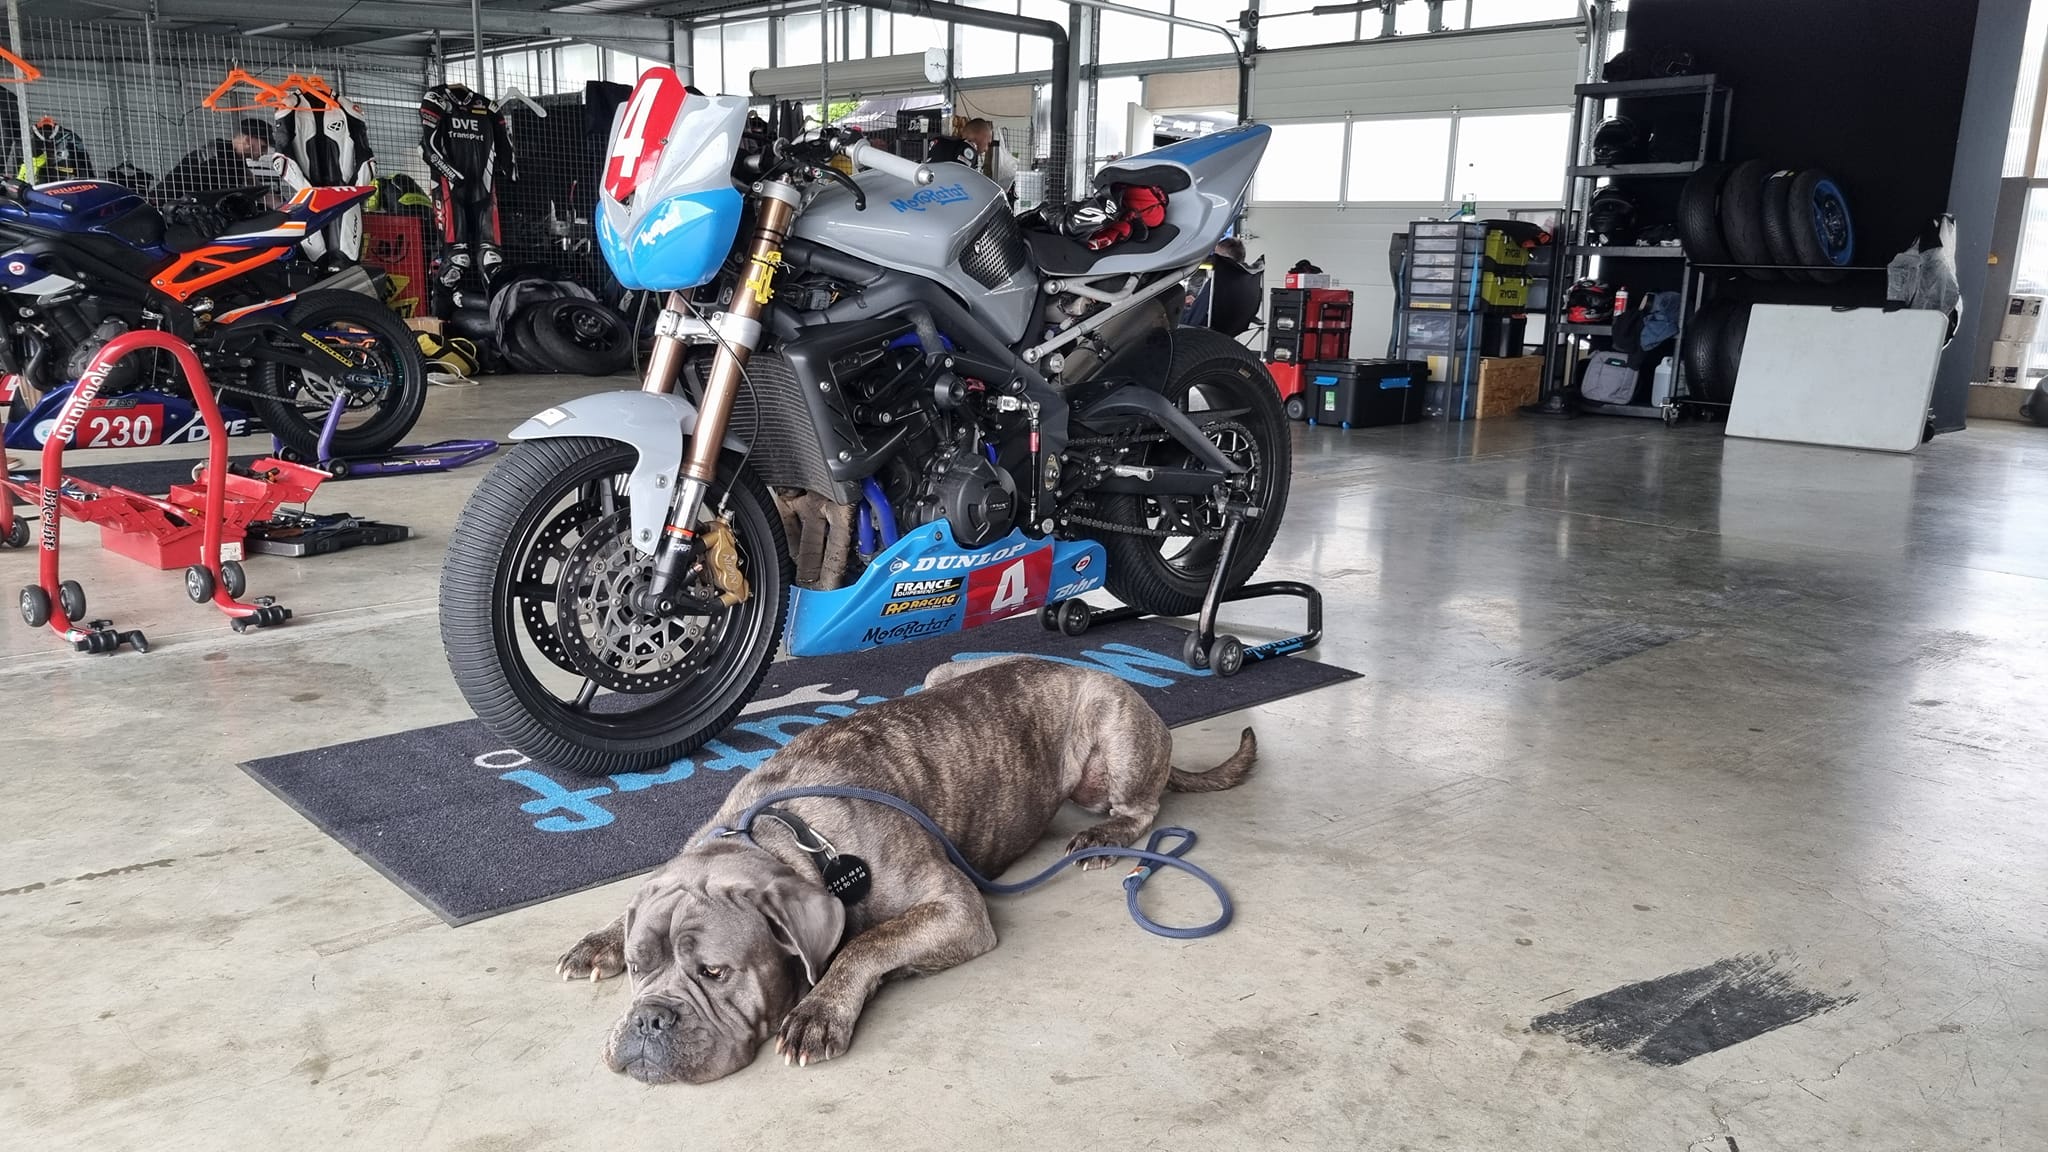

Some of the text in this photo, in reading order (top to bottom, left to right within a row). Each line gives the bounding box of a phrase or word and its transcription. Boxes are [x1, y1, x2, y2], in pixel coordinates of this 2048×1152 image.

[451, 117, 479, 131] DVE
[611, 78, 664, 178] 4
[89, 415, 153, 447] 230
[188, 419, 247, 442] DE
[911, 543, 1026, 572] DUNLOP
[895, 579, 953, 592] FRANCE
[991, 559, 1029, 614] 4
